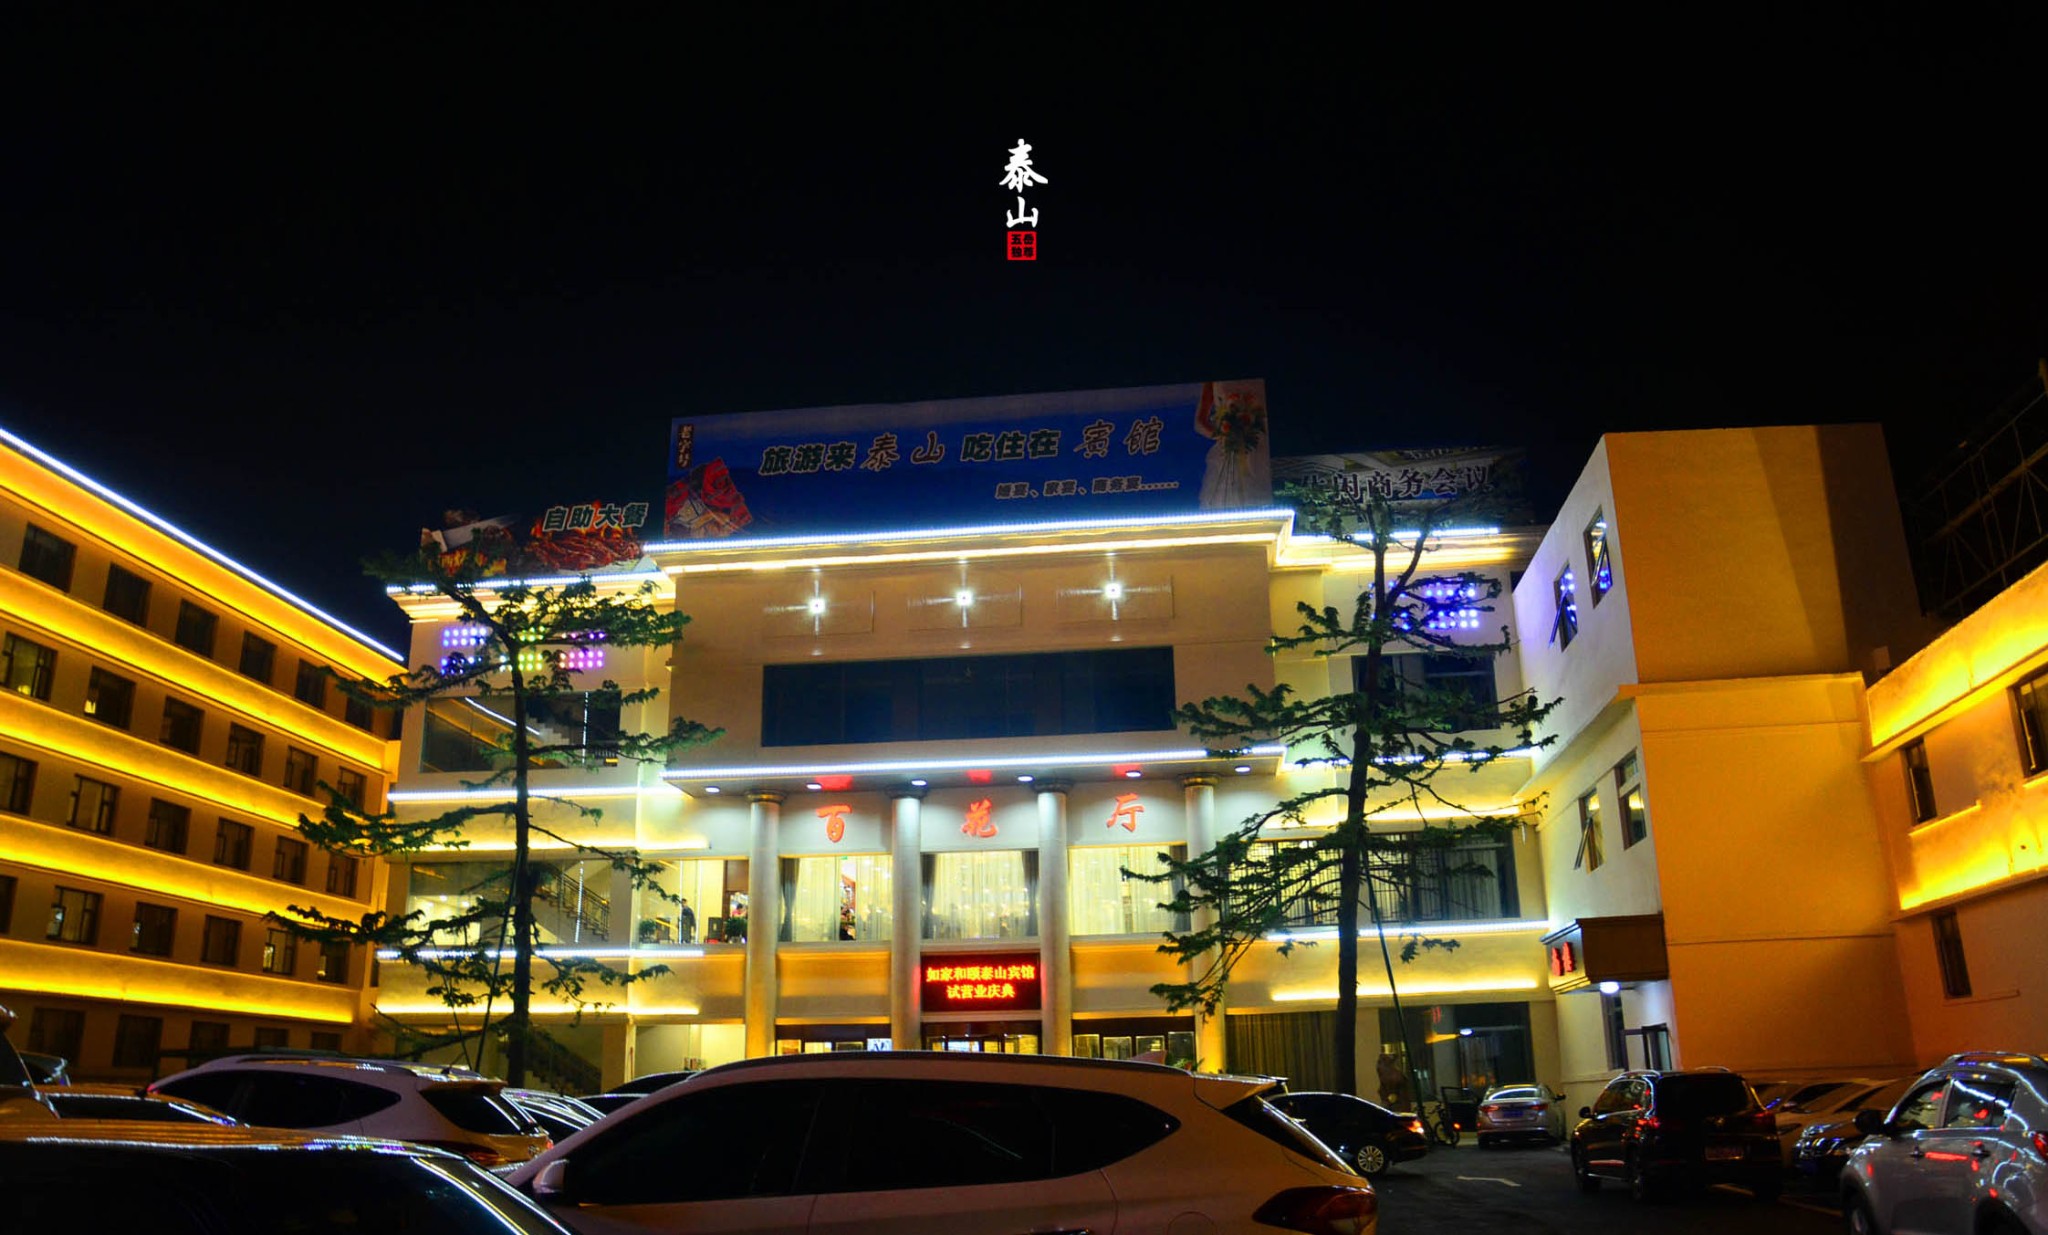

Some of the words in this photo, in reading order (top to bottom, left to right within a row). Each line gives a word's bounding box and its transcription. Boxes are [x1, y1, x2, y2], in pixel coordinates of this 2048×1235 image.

[542, 502, 649, 532] 自助大餐
[815, 792, 1146, 843] 百花厅
[925, 965, 1036, 982] 如家和颐泰山宾馆
[946, 983, 1016, 999] 试营业庆典
